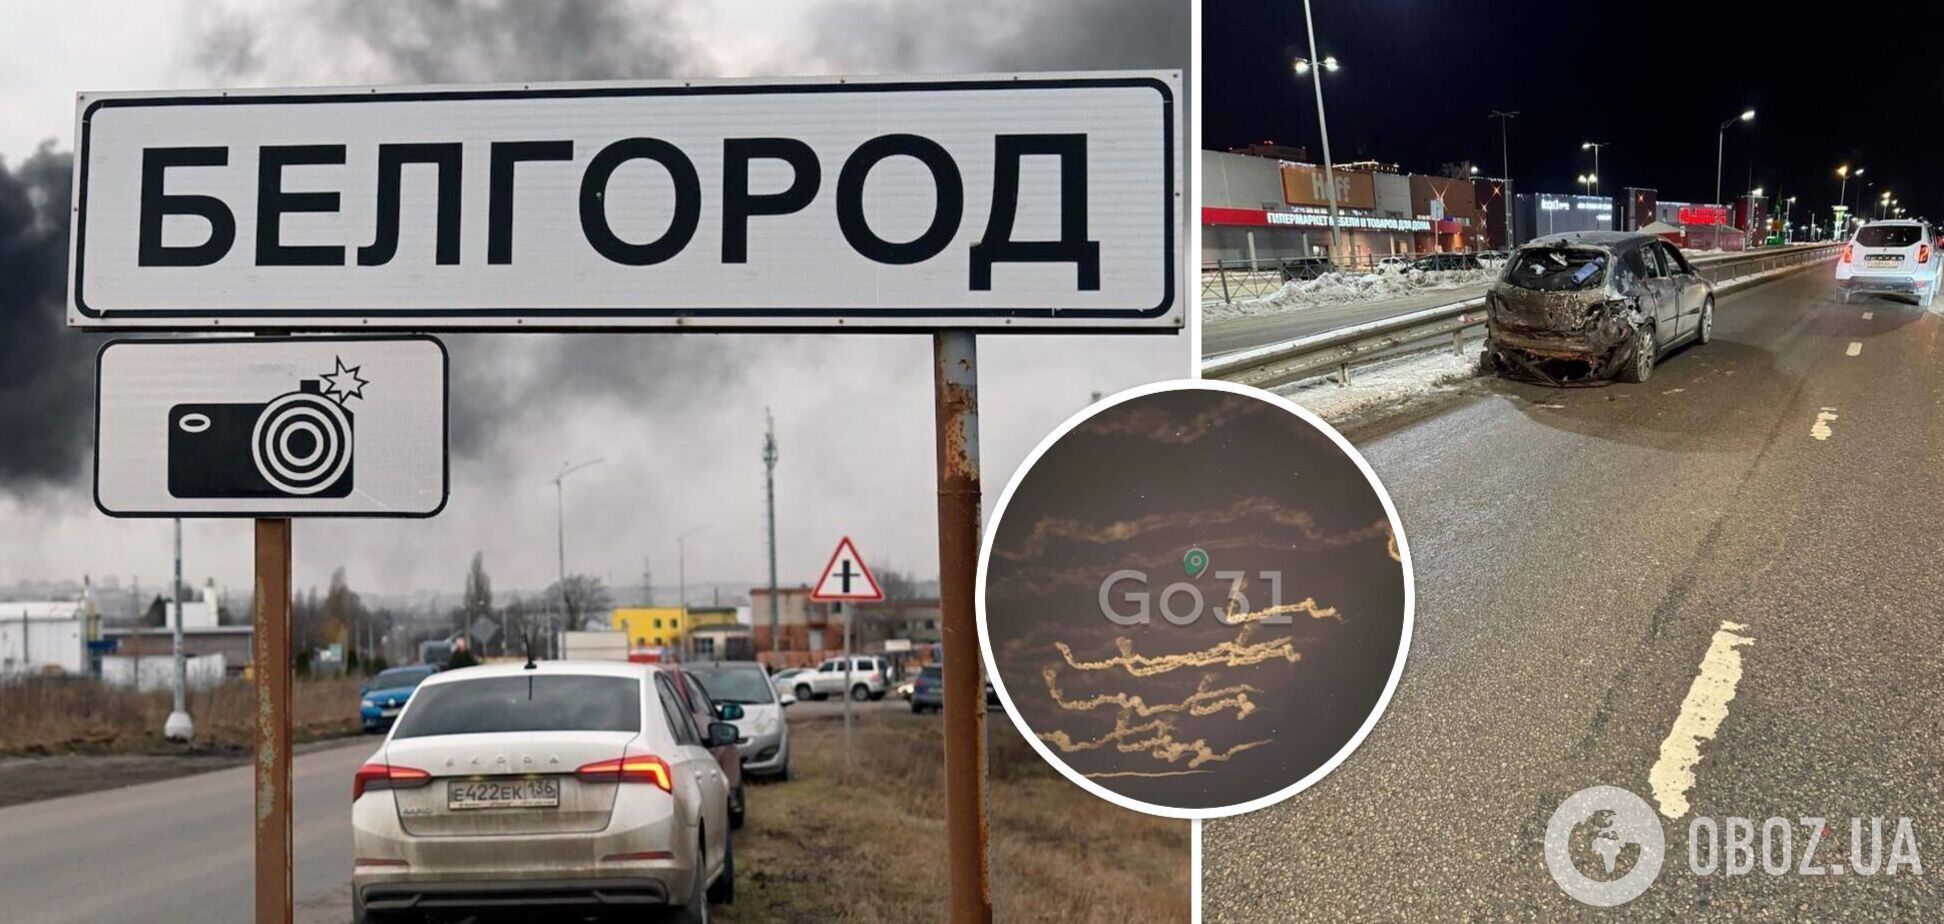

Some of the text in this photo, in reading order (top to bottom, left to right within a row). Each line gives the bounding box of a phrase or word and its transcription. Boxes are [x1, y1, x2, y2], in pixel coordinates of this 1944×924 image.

[1311, 171, 1350, 203] Hff
[137, 133, 1101, 292] БЕЛГОРОД
[1266, 212, 1328, 227] ГИПЕРМАРКЕТ
[1360, 217, 1366, 228] И
[1367, 217, 1397, 229] ТОВАРОВ
[1398, 219, 1411, 231] ДЛЯ
[1412, 220, 1431, 231] ДОМА
